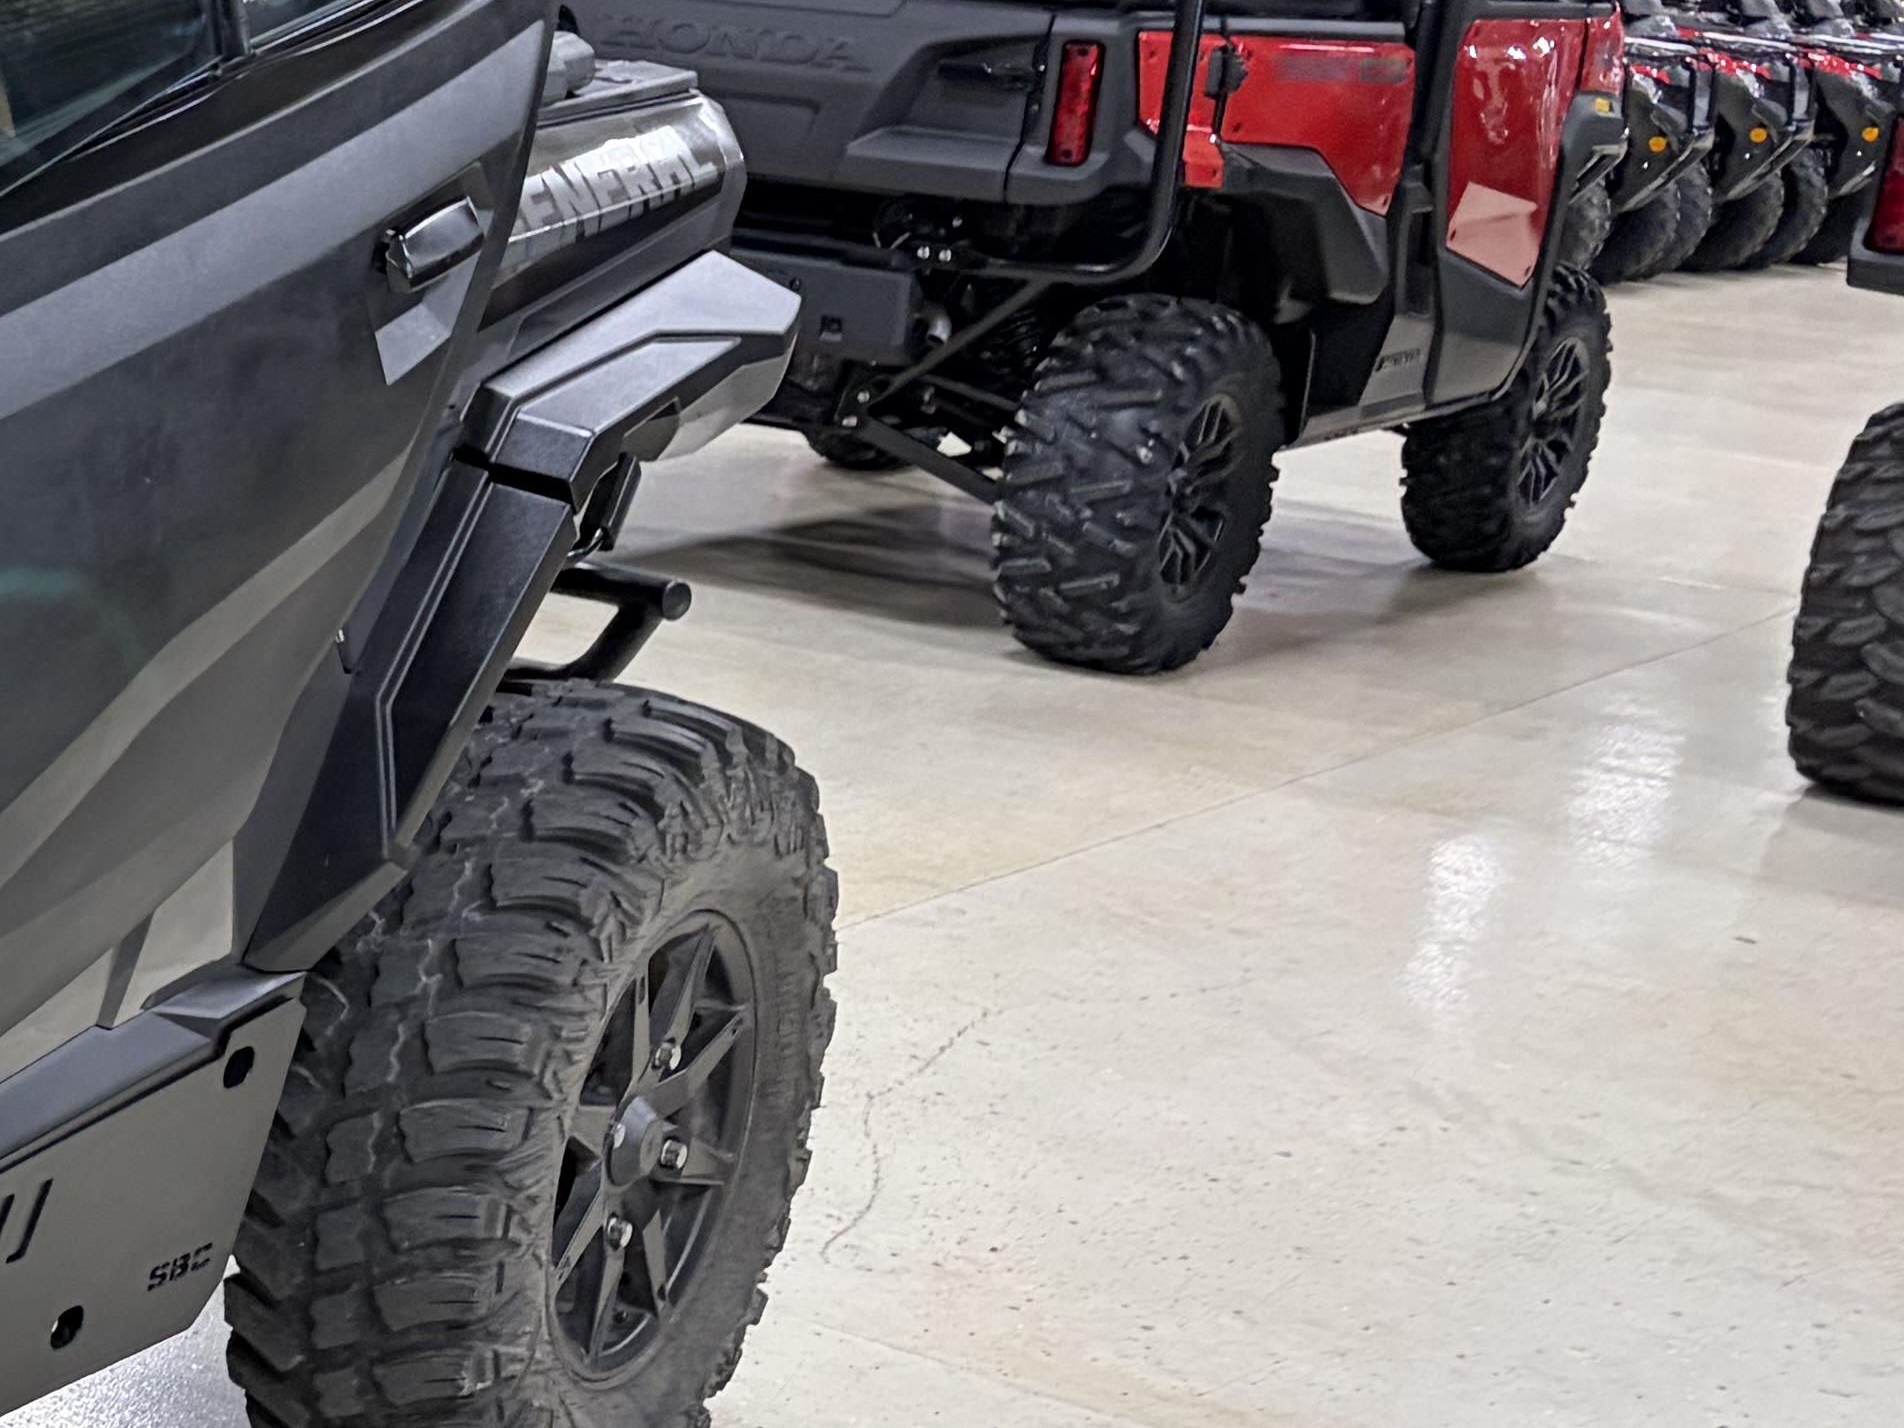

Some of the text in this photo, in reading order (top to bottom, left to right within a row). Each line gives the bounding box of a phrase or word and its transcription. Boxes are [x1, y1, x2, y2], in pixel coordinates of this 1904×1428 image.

[598, 15, 873, 72] HONDA
[506, 126, 719, 264] ENERAL
[147, 1242, 213, 1292] SBC
